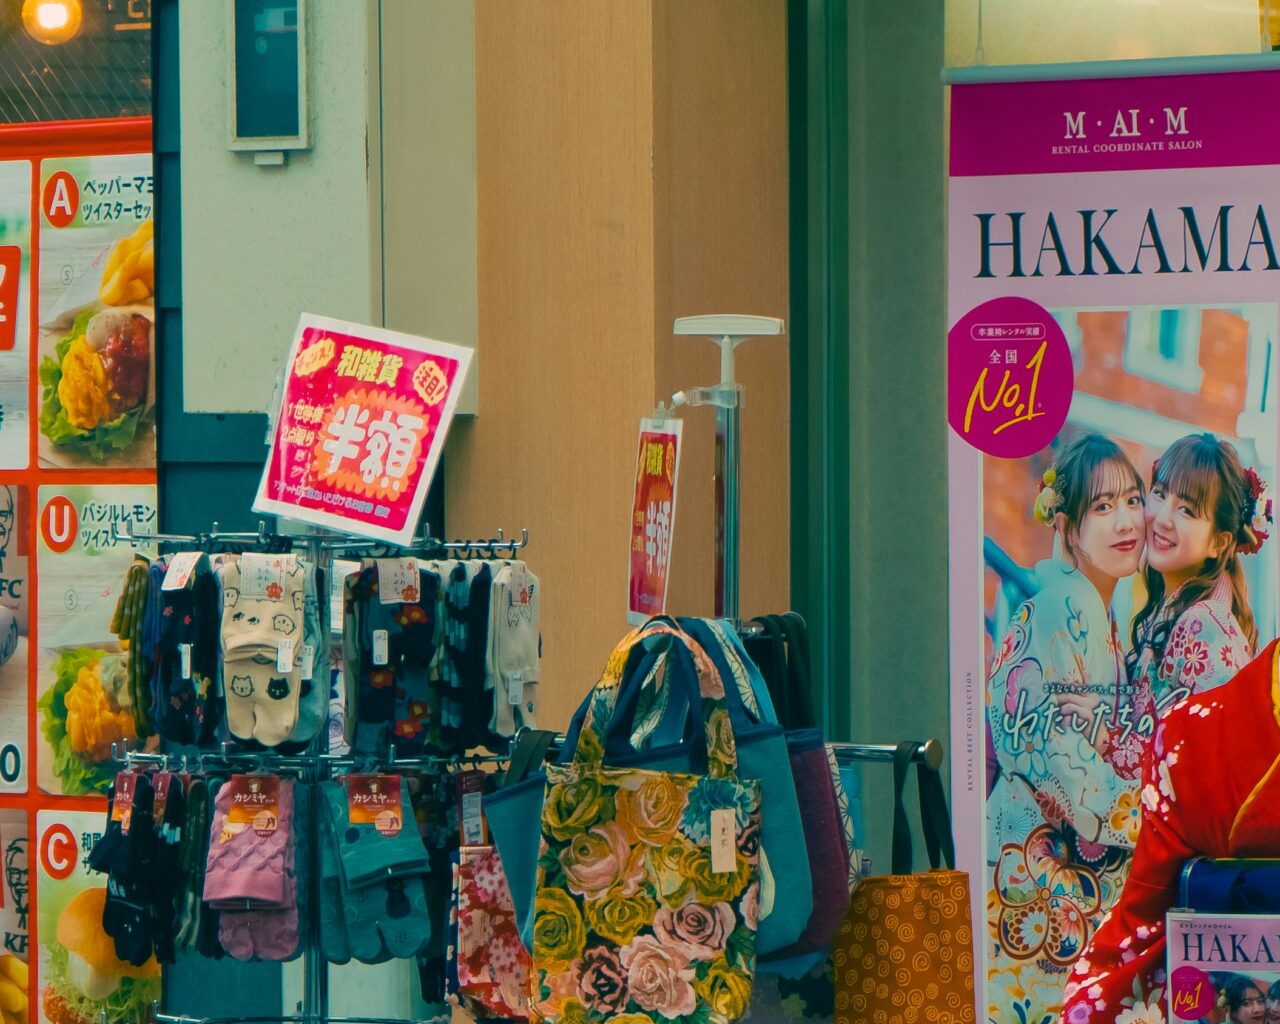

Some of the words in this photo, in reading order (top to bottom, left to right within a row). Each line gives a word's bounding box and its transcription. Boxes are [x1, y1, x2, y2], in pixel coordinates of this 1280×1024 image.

[1051, 144, 1091, 155] RENTAL
[1092, 141, 1165, 153] COORDINATE
[1167, 139, 1203, 150] SALON
[49, 178, 72, 217] A
[338, 344, 404, 388] 和雑貨
[988, 348, 1018, 364] 全国
[415, 364, 448, 402] 注目!
[322, 403, 425, 490] 半額
[49, 504, 70, 543] U
[82, 502, 157, 523] バジルレモン
[233, 792, 267, 804] カシミヤ
[352, 792, 388, 805] カシミヤ
[47, 832, 68, 871] C
